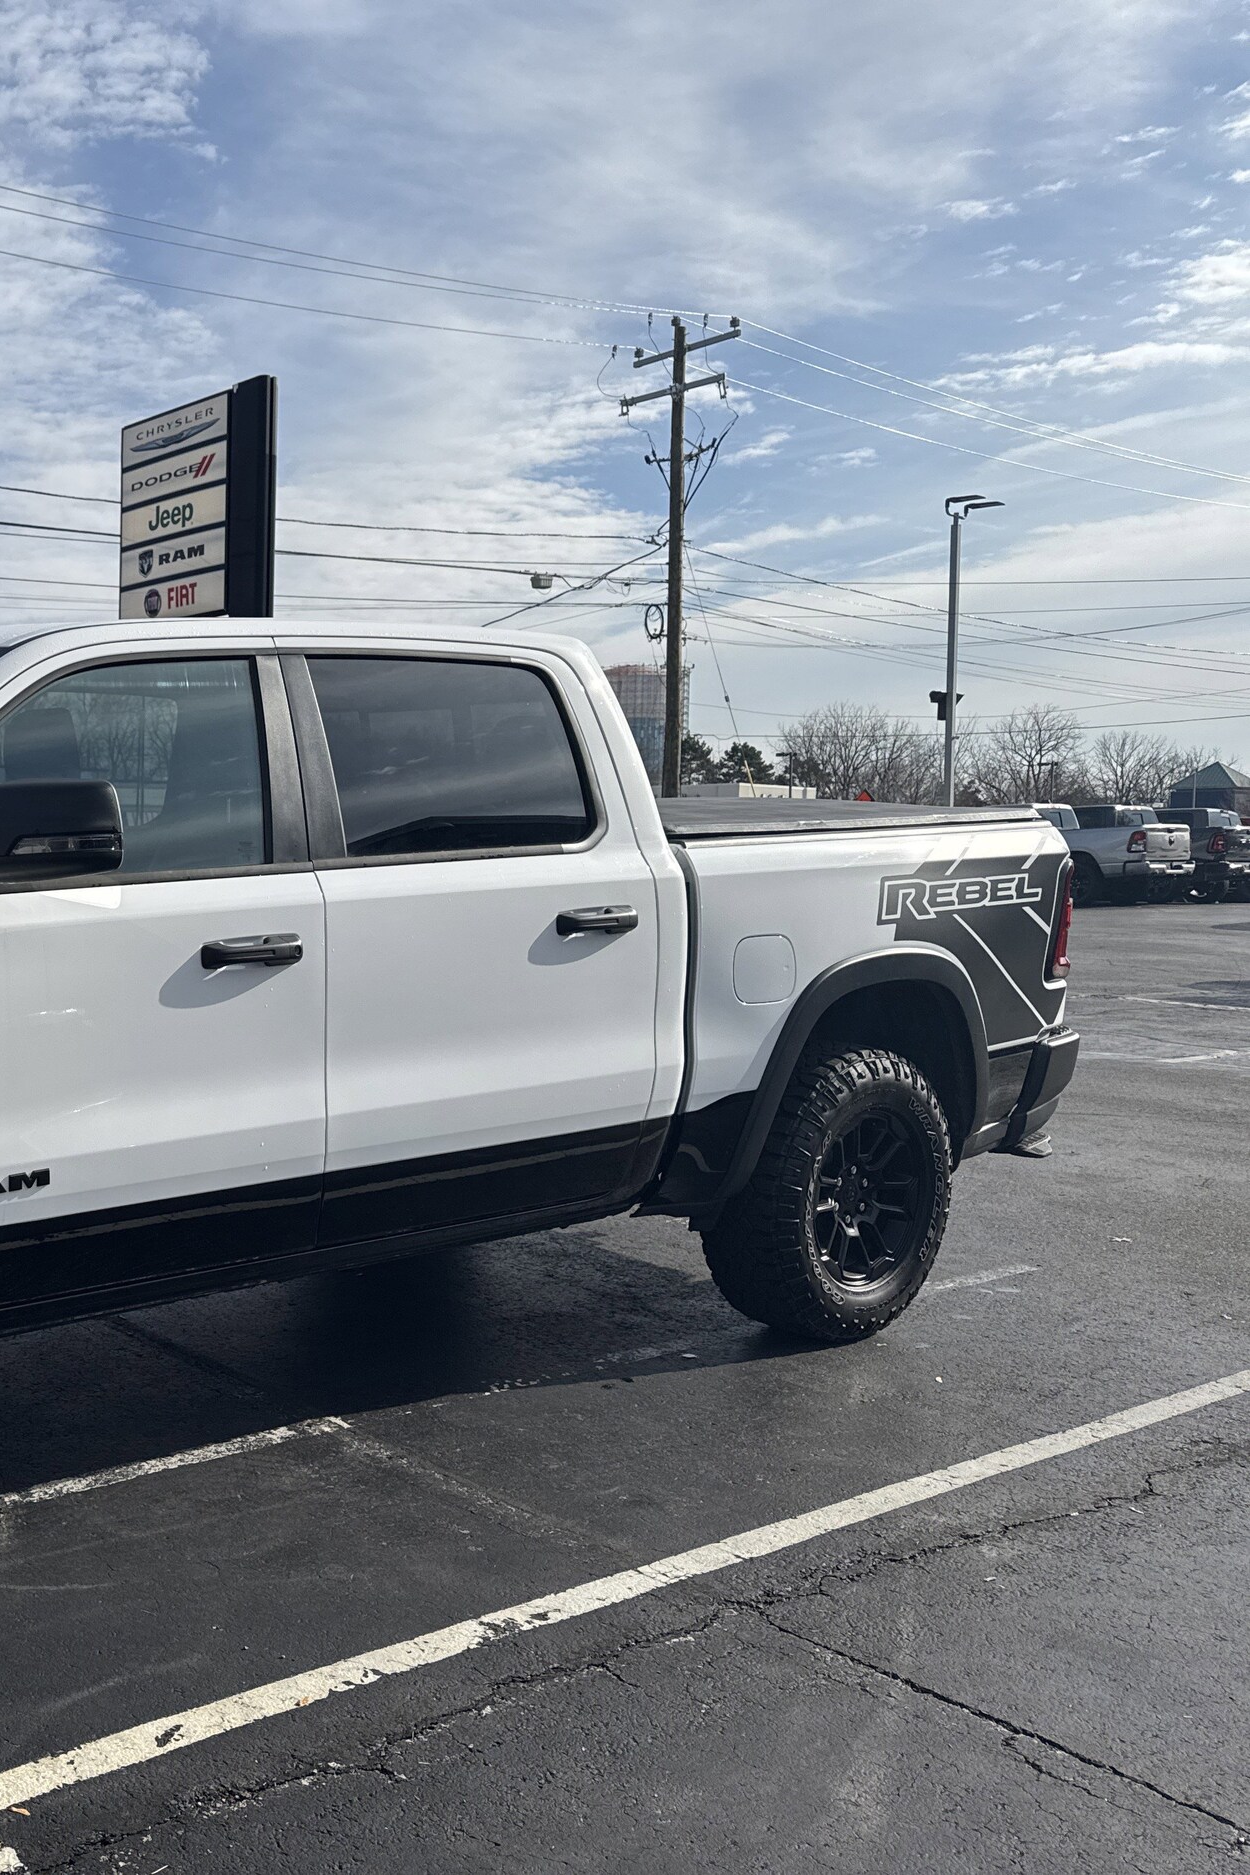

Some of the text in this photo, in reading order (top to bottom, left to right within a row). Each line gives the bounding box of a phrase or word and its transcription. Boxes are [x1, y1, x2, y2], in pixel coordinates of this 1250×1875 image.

[136, 407, 215, 441] CHRYSLER
[131, 462, 200, 492] DODGE
[148, 502, 194, 531] Jeep
[158, 545, 205, 566] RAM
[167, 582, 198, 609] FIAT
[881, 873, 1043, 920] REBEL
[909, 1097, 945, 1261] WRANGLER
